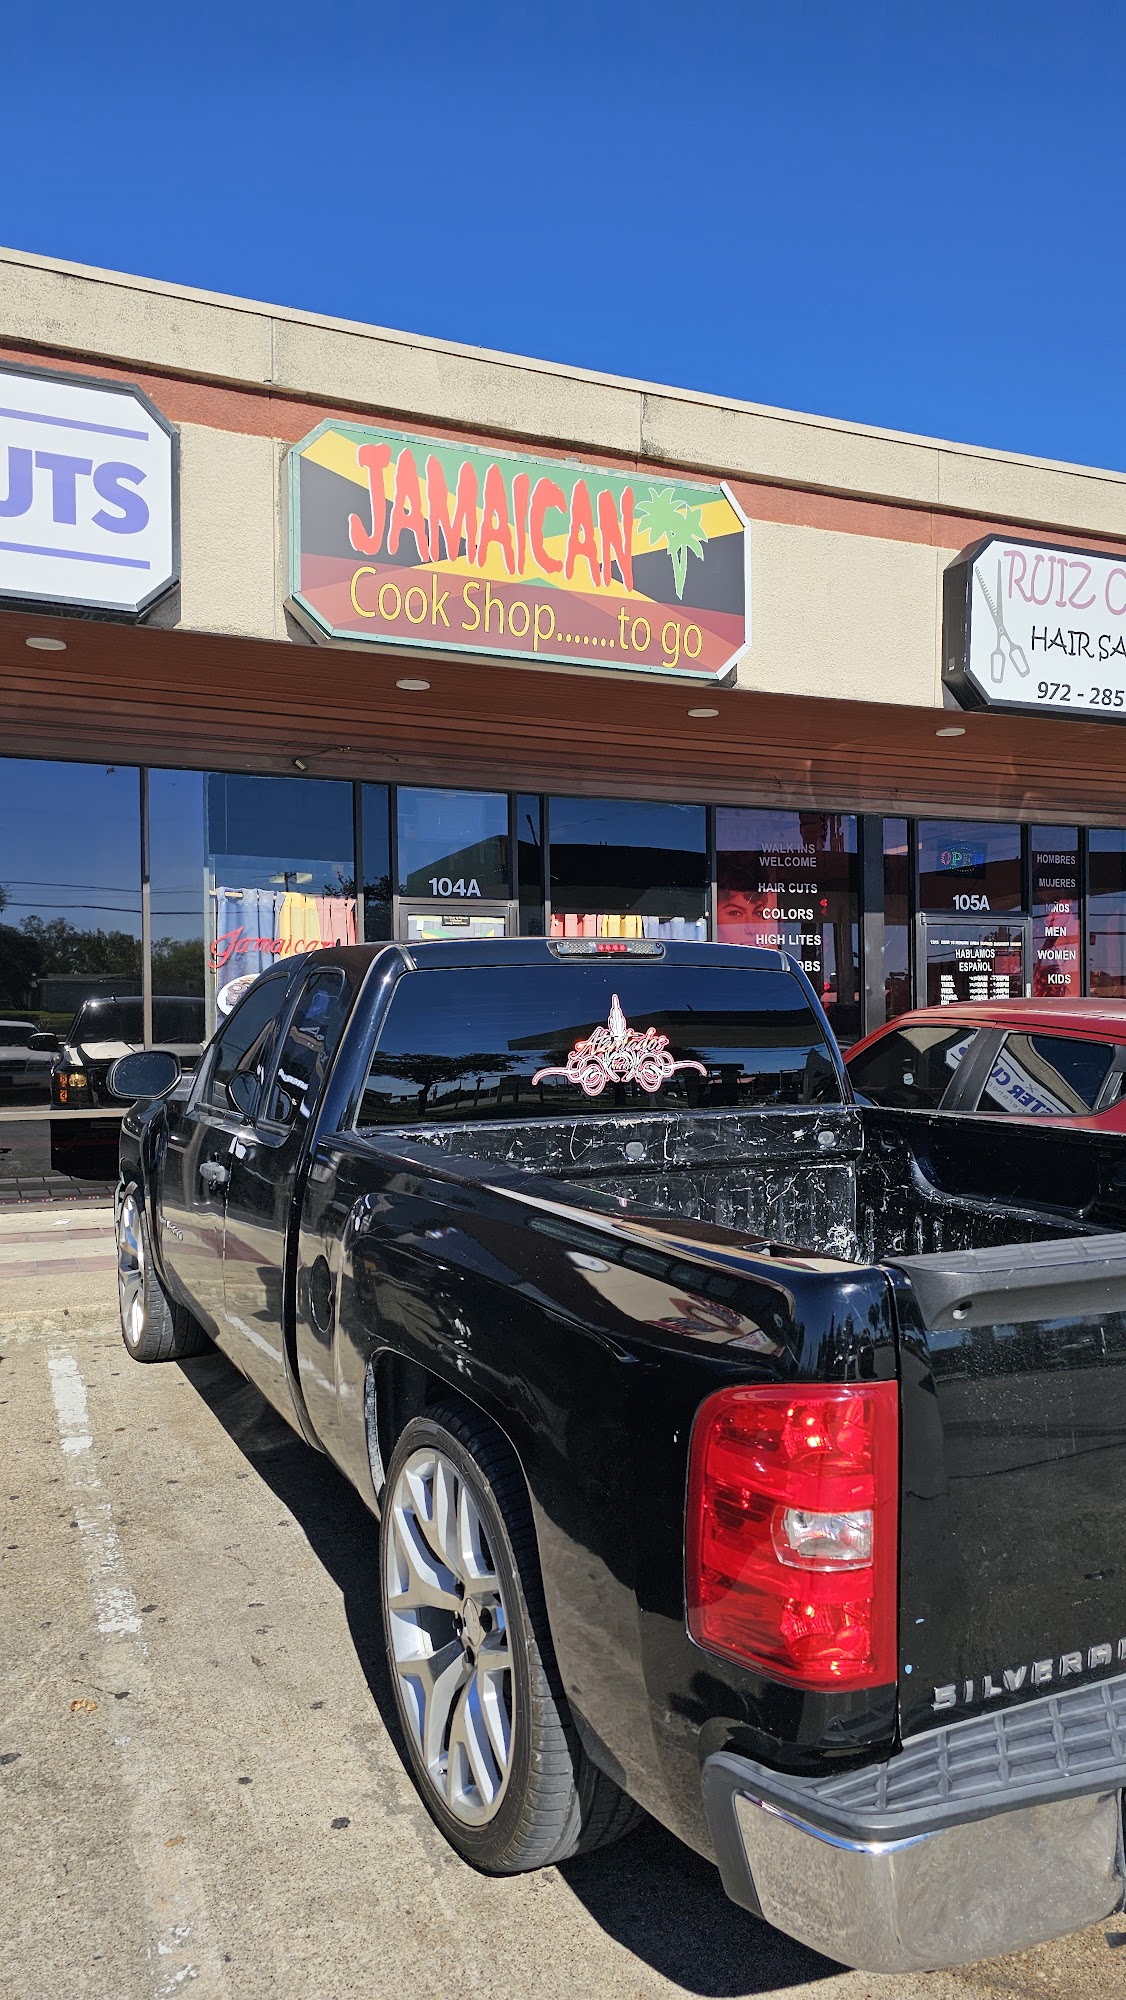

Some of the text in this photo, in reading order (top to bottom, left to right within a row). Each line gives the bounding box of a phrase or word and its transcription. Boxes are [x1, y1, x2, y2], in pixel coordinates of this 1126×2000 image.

[348, 442, 635, 593] JAMAICAN
[1003, 550, 1096, 609] RUIZ
[350, 566, 451, 628] Cook
[660, 620, 703, 668] go
[1031, 626, 1126, 662] HAIR SA
[1037, 681, 1071, 702] 972
[1089, 687, 1125, 707] 285
[761, 843, 816, 854] WALK INS
[759, 856, 817, 867] WELCOME
[1036, 854, 1076, 865] HOMBRES
[428, 877, 482, 897] 104A
[758, 882, 818, 894] HAIR CUTS
[1038, 878, 1076, 888] MUJERES
[952, 894, 991, 911] 105A
[1045, 901, 1070, 913] NIÑOS
[762, 908, 814, 920] COLORS
[1045, 927, 1067, 937] MEN
[755, 934, 822, 946] HIGH LITES
[955, 948, 996, 959] HABLAMOS
[1037, 950, 1076, 960] WOMEN
[959, 959, 992, 972] ESPAÑOL
[1047, 973, 1072, 984] KIDS
